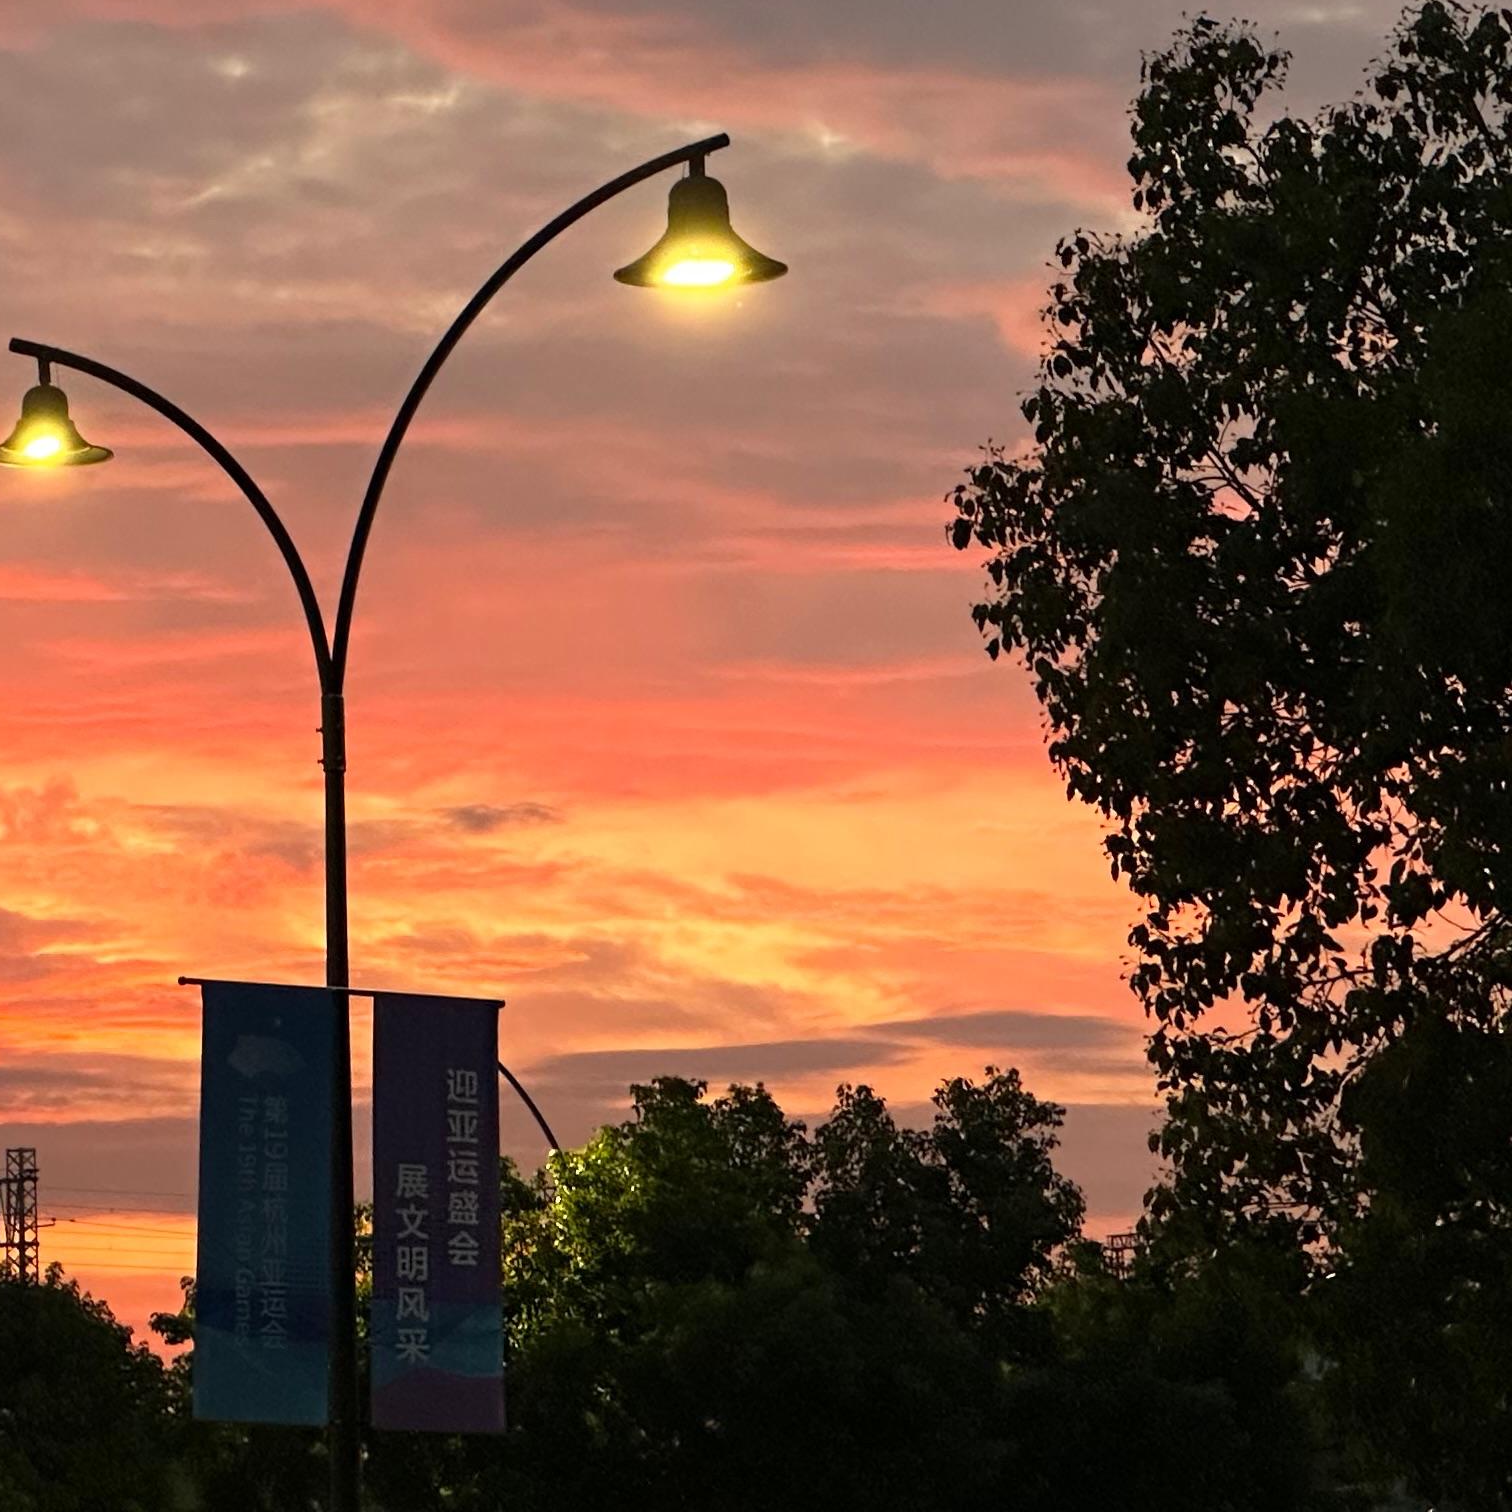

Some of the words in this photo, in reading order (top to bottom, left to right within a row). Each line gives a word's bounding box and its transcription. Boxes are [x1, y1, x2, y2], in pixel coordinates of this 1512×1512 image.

[238, 1096, 258, 1137] The
[238, 1143, 258, 1192] 19th
[446, 1068, 480, 1266] 迎亚运盛会
[235, 1199, 256, 1262] Asian
[261, 1096, 289, 1349] 第19届杭州亚运会
[395, 1163, 429, 1364] 展文明风采
[234, 1267, 256, 1347] Games
